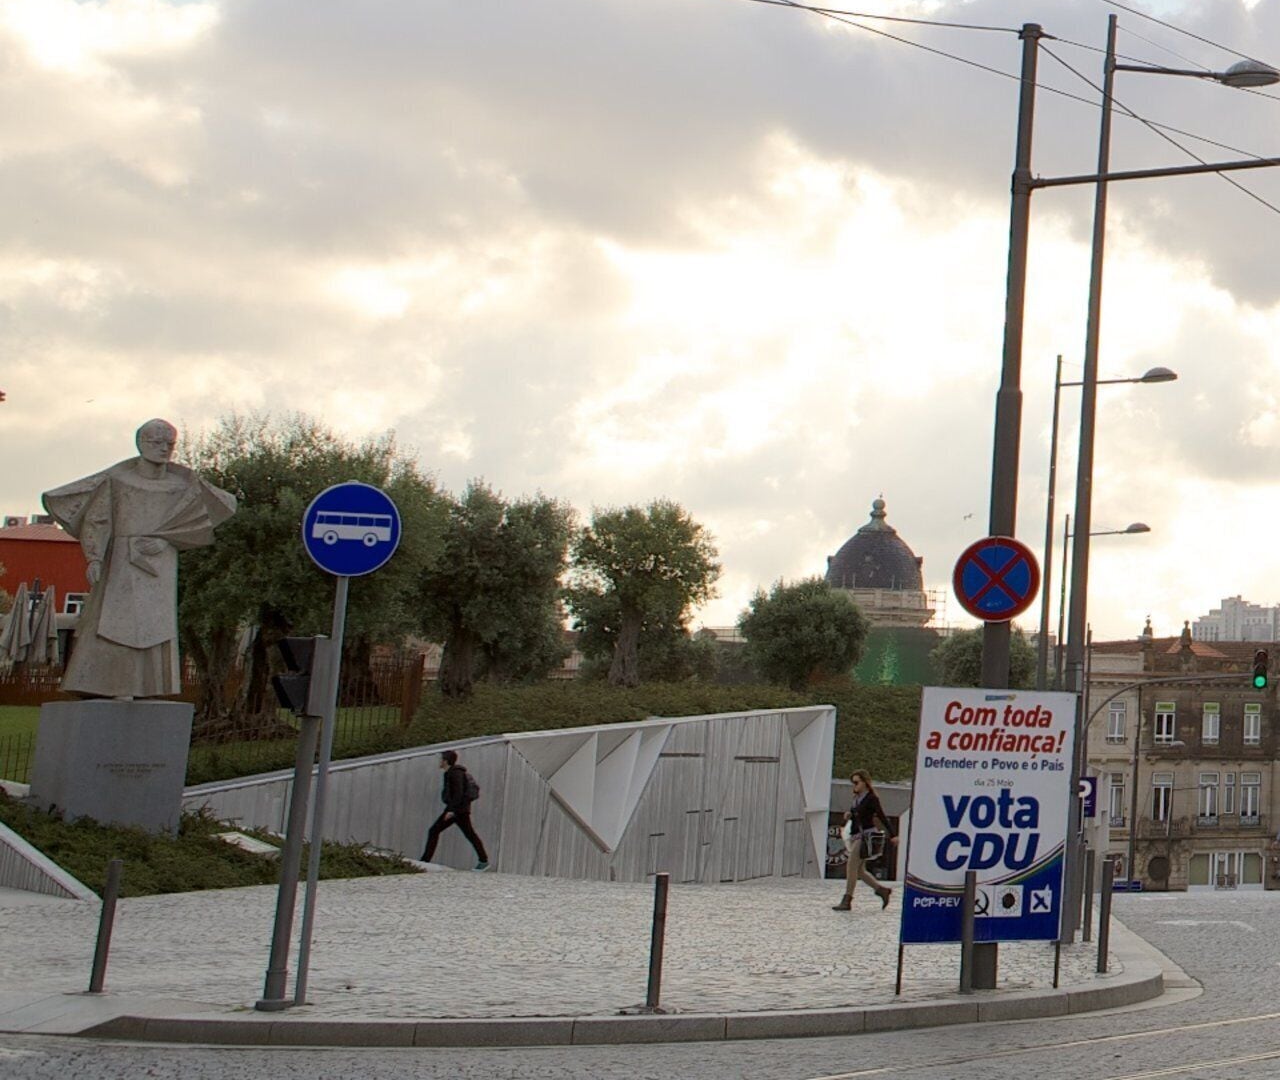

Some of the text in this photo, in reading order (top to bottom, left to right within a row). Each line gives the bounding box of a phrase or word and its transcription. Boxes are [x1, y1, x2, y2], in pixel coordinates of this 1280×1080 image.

[944, 701, 1053, 728] Com toda
[926, 728, 1066, 759] a confiança!
[924, 756, 978, 769] Defender
[981, 760, 989, 769] o
[991, 758, 1019, 770] Povo
[1021, 760, 1029, 770] e
[1031, 761, 1038, 770] o
[942, 789, 1040, 829] vota
[935, 832, 1040, 871] CDU
[913, 897, 961, 908] PCP-PEV
